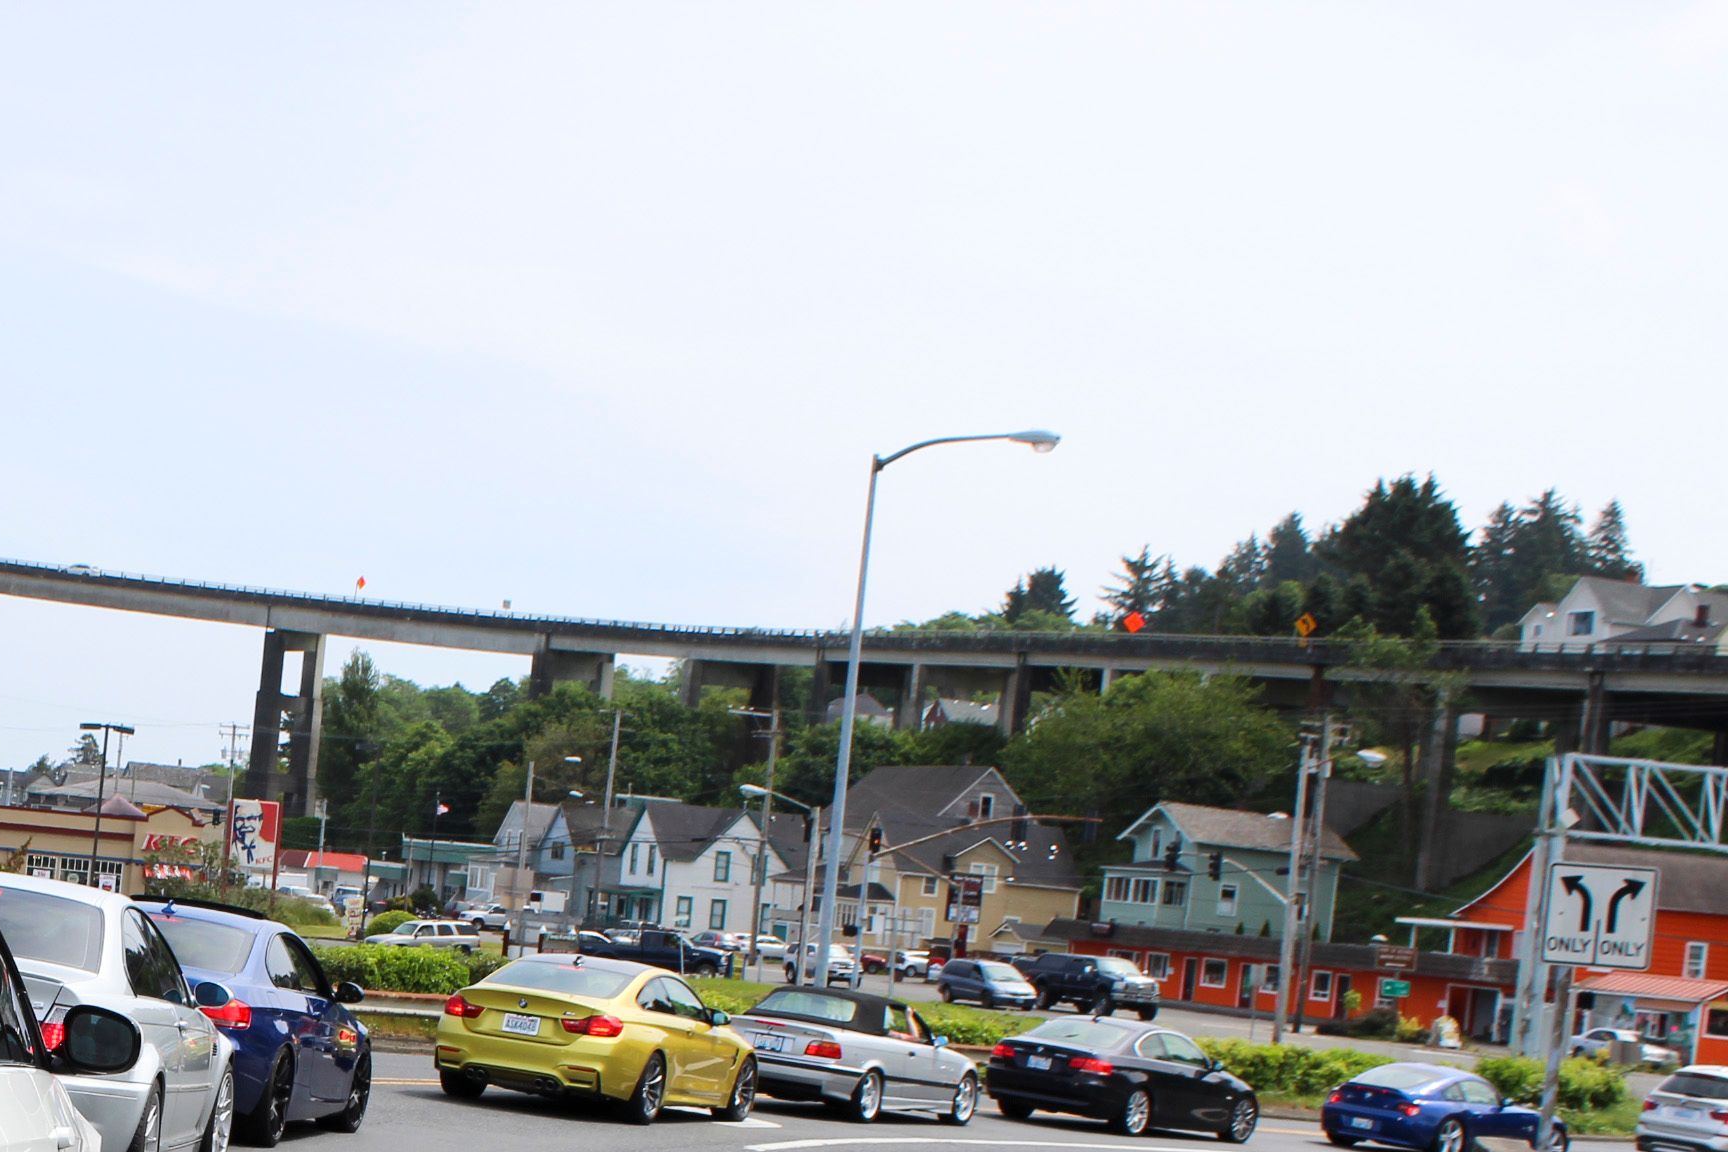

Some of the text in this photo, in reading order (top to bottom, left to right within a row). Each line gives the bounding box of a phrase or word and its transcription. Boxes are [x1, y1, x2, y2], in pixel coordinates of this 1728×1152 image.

[255, 855, 272, 864] KFC
[1546, 936, 1645, 957] ONLY ONLY
